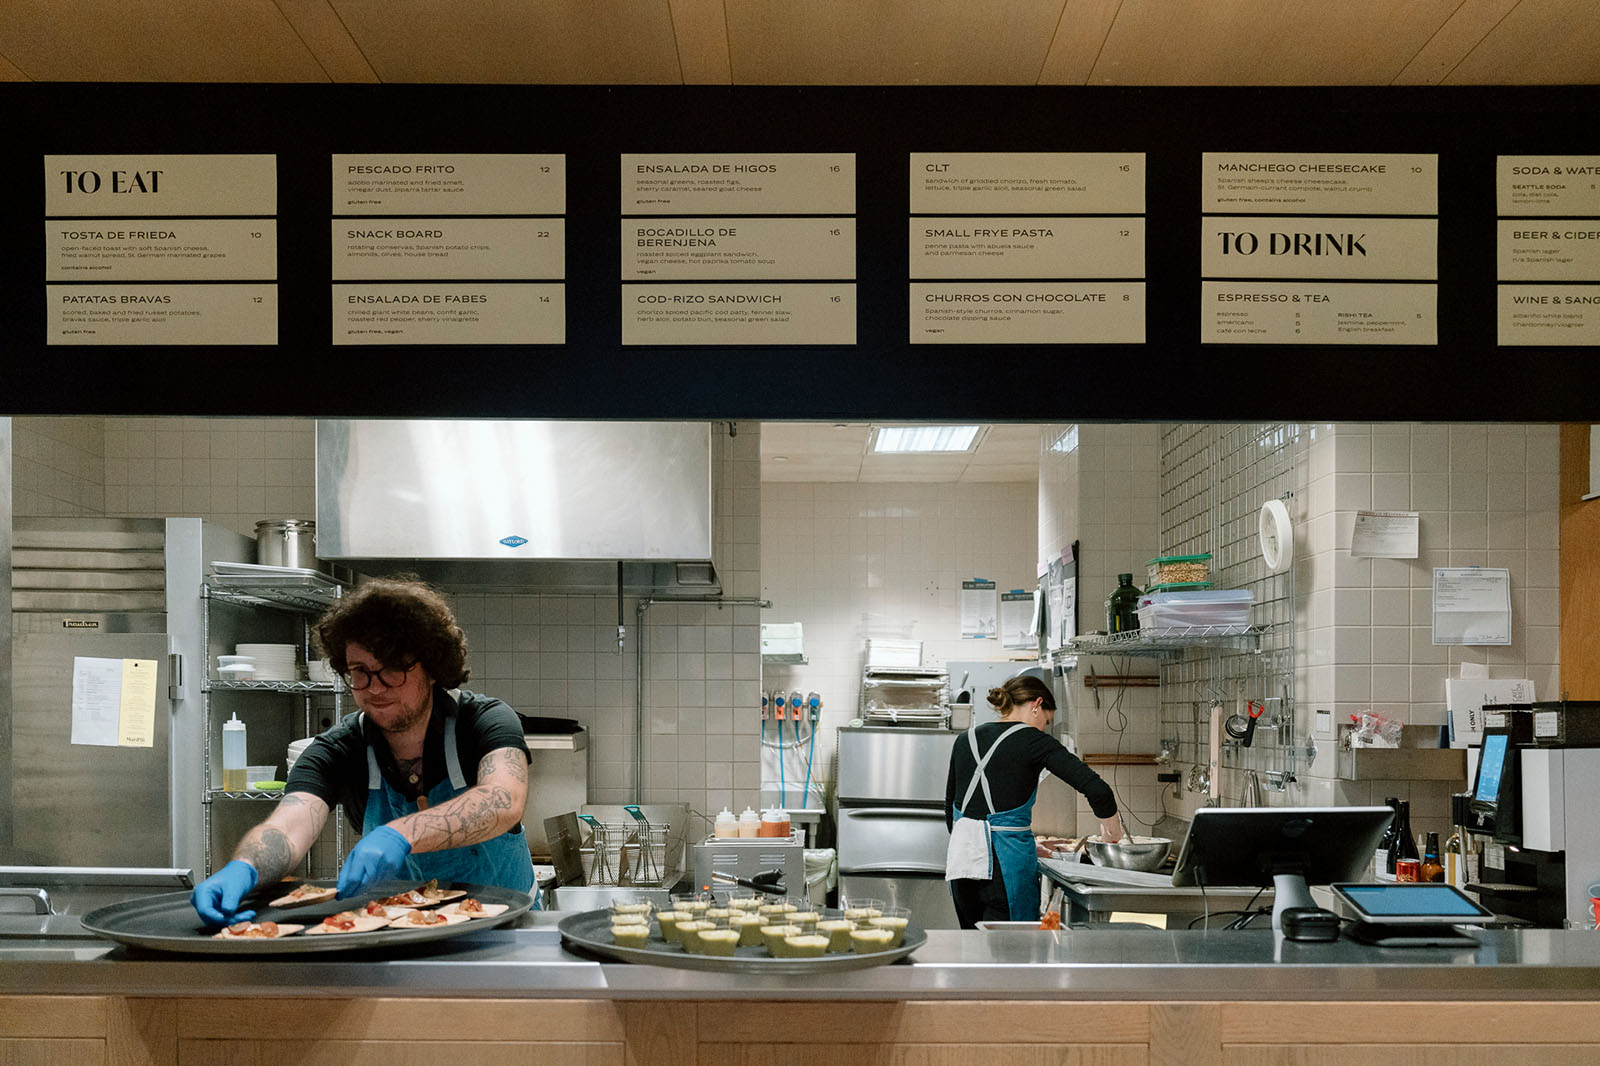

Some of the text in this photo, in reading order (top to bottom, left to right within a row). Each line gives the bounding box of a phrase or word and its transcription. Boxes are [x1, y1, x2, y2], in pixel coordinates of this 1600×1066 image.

[348, 165, 455, 174] PESCADO FRITO
[637, 165, 777, 173] ENSALADA DE HIGOS
[829, 165, 841, 173] 16
[925, 164, 950, 172] CLT
[1218, 164, 1386, 173] MANCHEGO CHEESECAKE
[1512, 167, 1550, 175] SODA
[1553, 167, 1562, 175] &
[60, 171, 164, 194] TO EAT
[61, 231, 177, 240] TOSTA DE FRIEDA
[347, 230, 443, 239] SNACK BOARD
[637, 228, 737, 237] BOCADILLO DE
[925, 229, 1054, 238] SMALL FRYE PASTA
[1513, 231, 1548, 239] BEER
[1551, 231, 1561, 240] &
[637, 239, 717, 247] BERENJENA
[1217, 232, 1366, 256] TO DRINK
[62, 295, 171, 304] PATATAS BRAVAS
[348, 295, 487, 304] ENSALADA DE FABES
[637, 295, 782, 304] COD-RIZO SANDWICH
[925, 294, 1106, 302] CHURROS CON CHOCOLATE
[1122, 294, 1130, 302] 8
[1218, 294, 1330, 303] ESPRESSO & TEA
[1513, 296, 1549, 304] WINE
[1552, 296, 1561, 305] &
